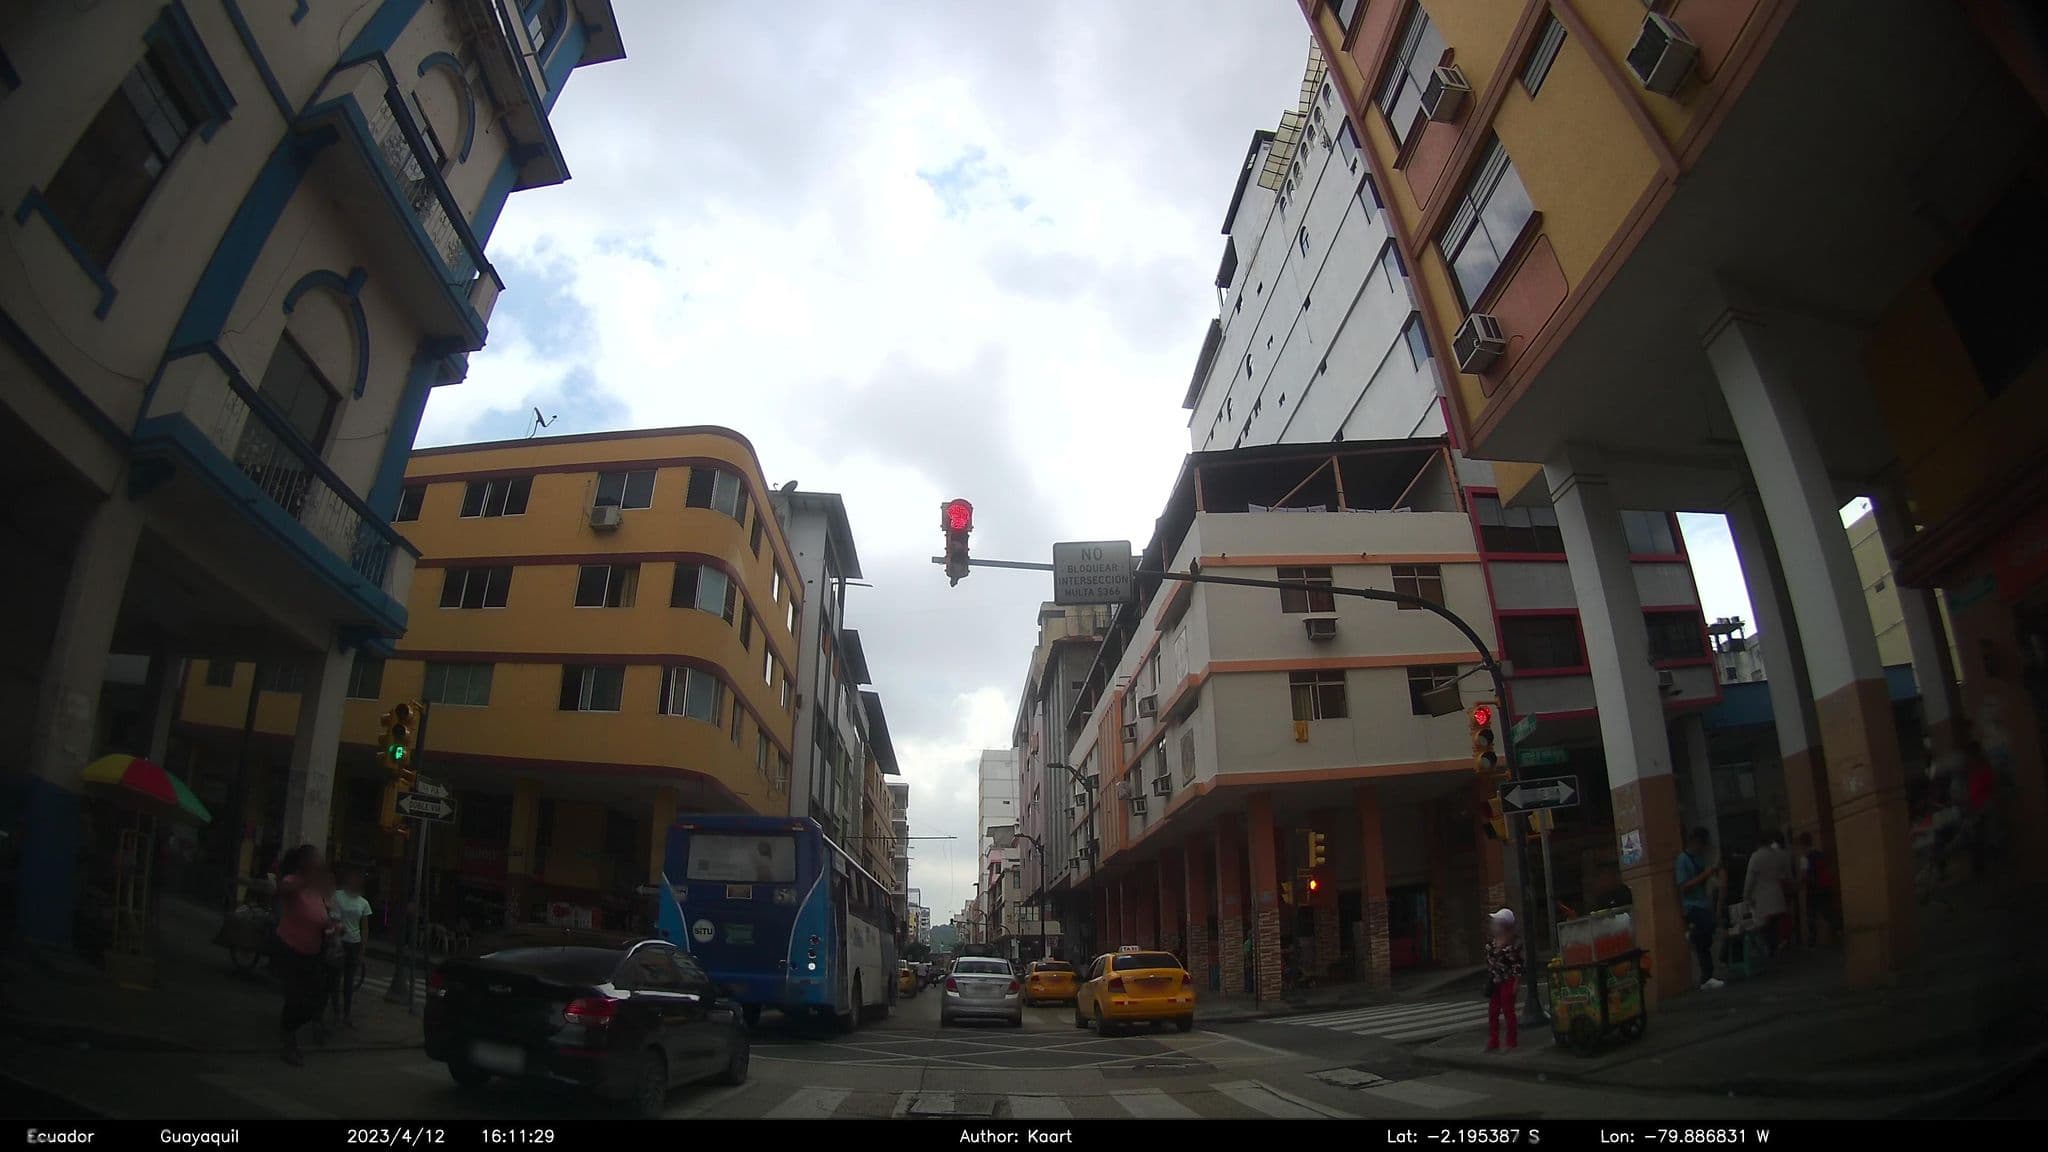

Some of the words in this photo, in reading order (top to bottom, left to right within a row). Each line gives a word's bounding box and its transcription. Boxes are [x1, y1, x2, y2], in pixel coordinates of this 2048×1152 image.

[1081, 547, 1103, 561] NO
[1067, 563, 1118, 574] BLOQUEAR
[1064, 588, 1095, 598] MULTA
